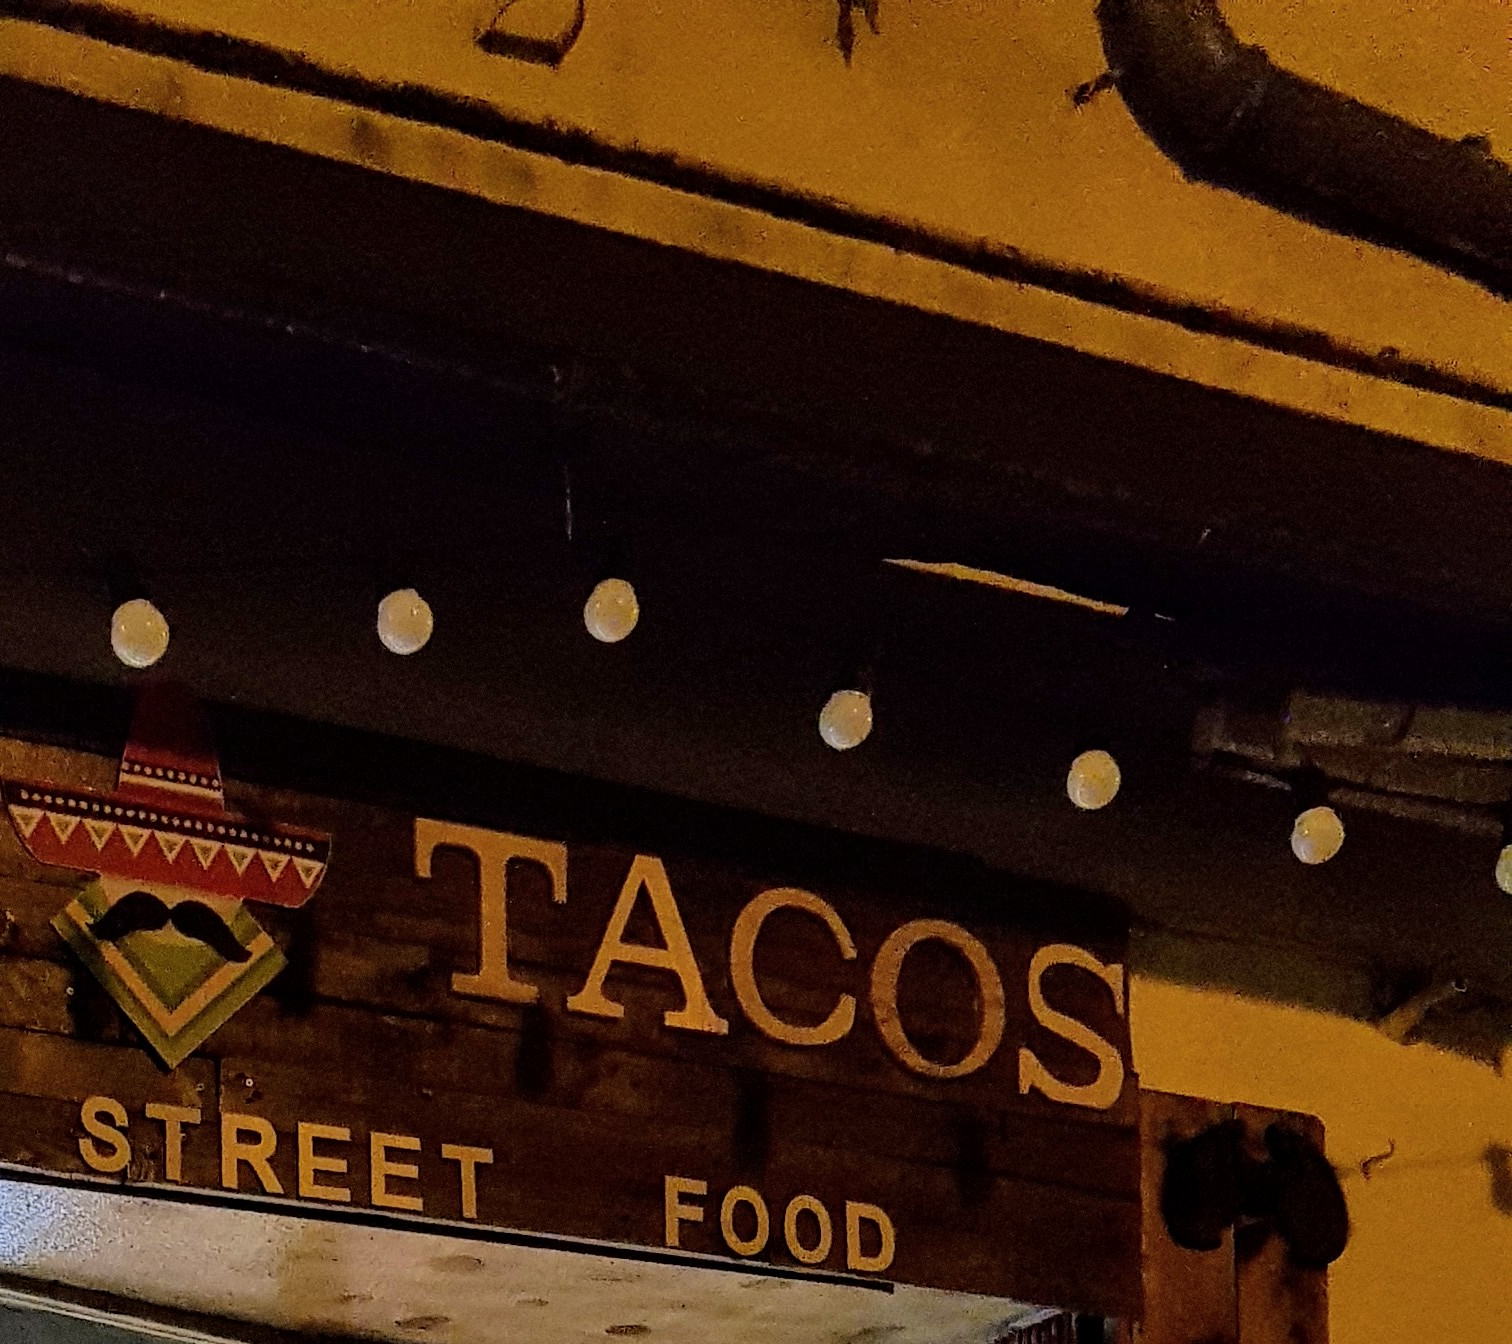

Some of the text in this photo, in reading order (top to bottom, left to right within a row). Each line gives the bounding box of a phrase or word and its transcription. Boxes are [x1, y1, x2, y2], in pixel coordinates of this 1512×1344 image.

[414, 817, 1126, 1110] TACOS
[79, 1095, 494, 1219] STREET
[662, 1175, 896, 1273] FOOD
